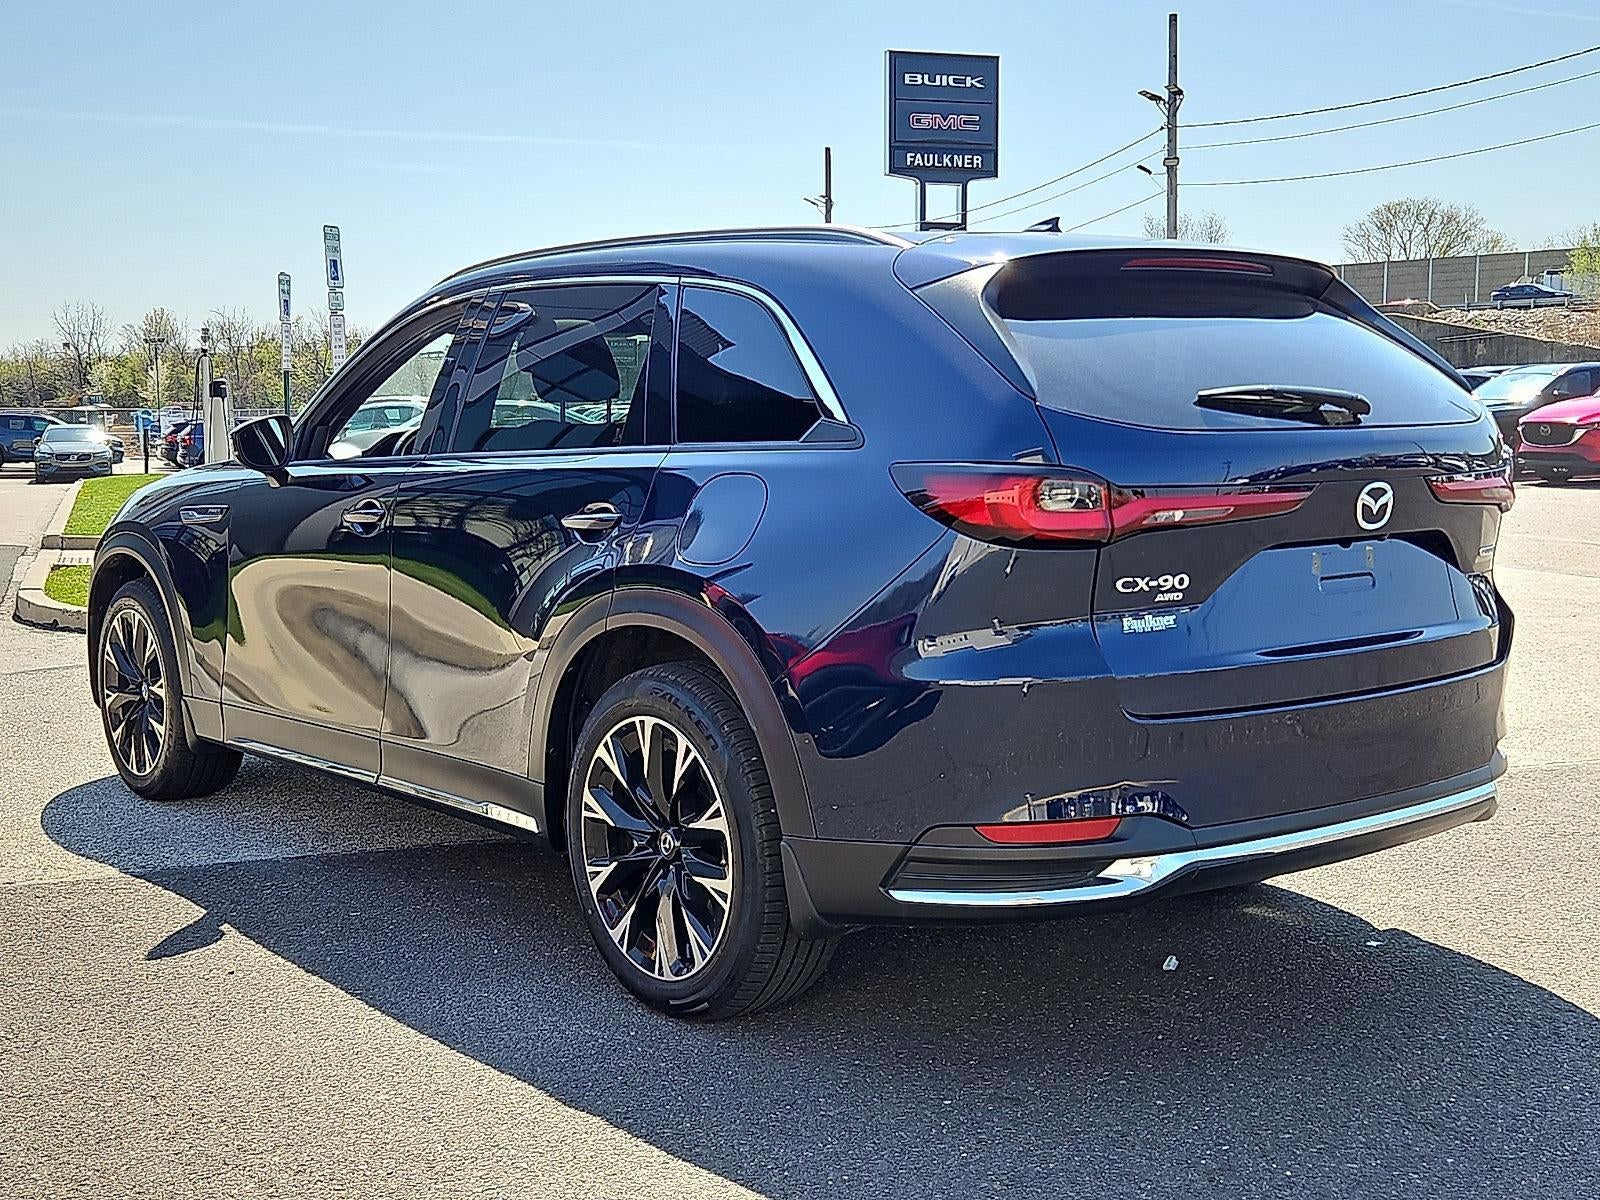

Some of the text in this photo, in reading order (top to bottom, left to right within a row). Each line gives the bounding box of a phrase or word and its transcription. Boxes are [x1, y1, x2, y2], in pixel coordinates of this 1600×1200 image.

[904, 73, 986, 88] BUICK
[909, 113, 981, 131] GMC
[906, 153, 983, 168] FAULKNER
[1115, 573, 1190, 593] CX-90
[1154, 592, 1184, 602] AWD
[1122, 614, 1177, 630] Faulkner
[649, 686, 719, 751] FALKEN
